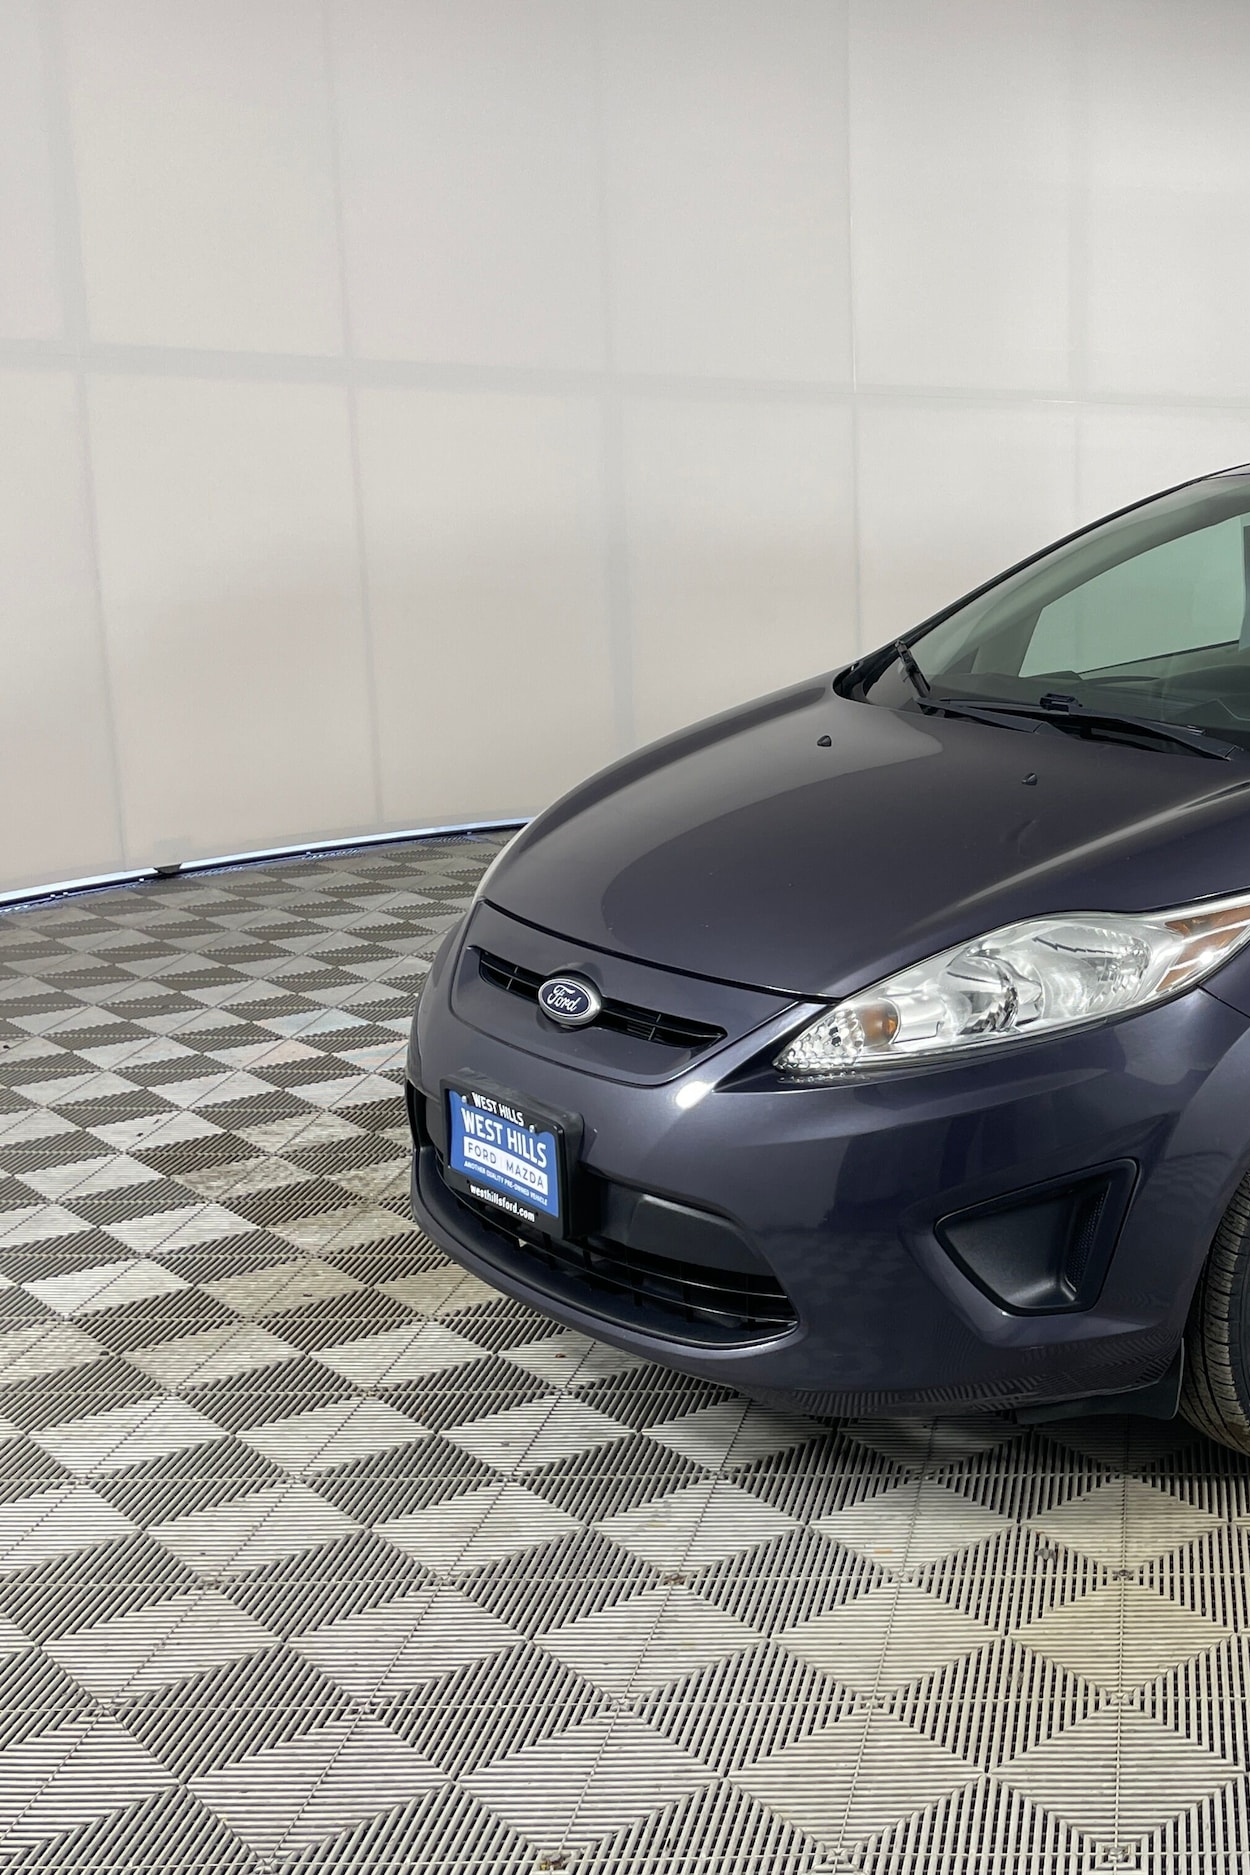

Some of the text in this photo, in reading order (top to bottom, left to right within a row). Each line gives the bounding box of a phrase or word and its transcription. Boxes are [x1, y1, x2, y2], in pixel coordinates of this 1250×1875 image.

[547, 985, 581, 1012] Ford
[471, 1092, 525, 1127] WEST HILLS
[461, 1107, 547, 1168] WEST HILLS
[468, 1142, 545, 1188] FORD MAZDA
[470, 1184, 535, 1222] westhillsford.com
